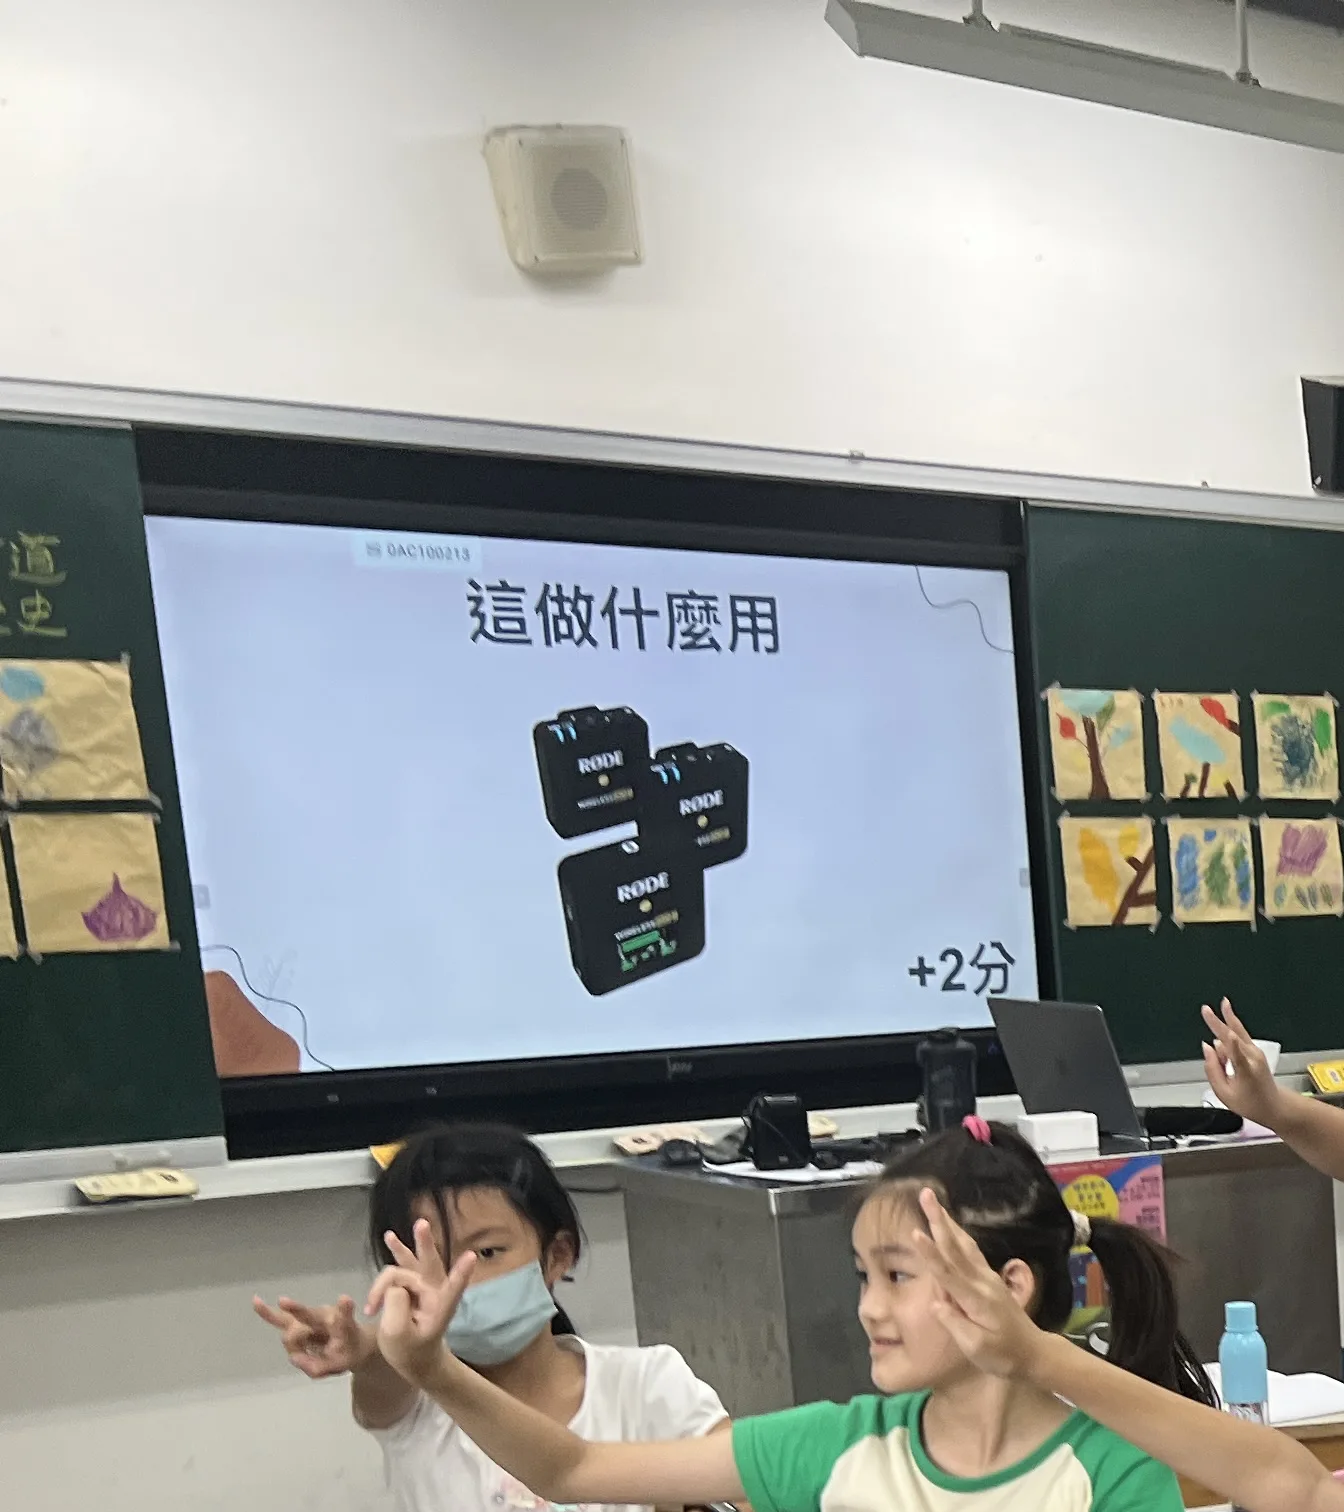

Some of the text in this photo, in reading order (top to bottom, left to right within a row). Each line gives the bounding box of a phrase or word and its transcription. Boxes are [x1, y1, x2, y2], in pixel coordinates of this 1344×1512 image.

[466, 577, 781, 655] 這做什麼用
[908, 940, 1016, 996] +2分
